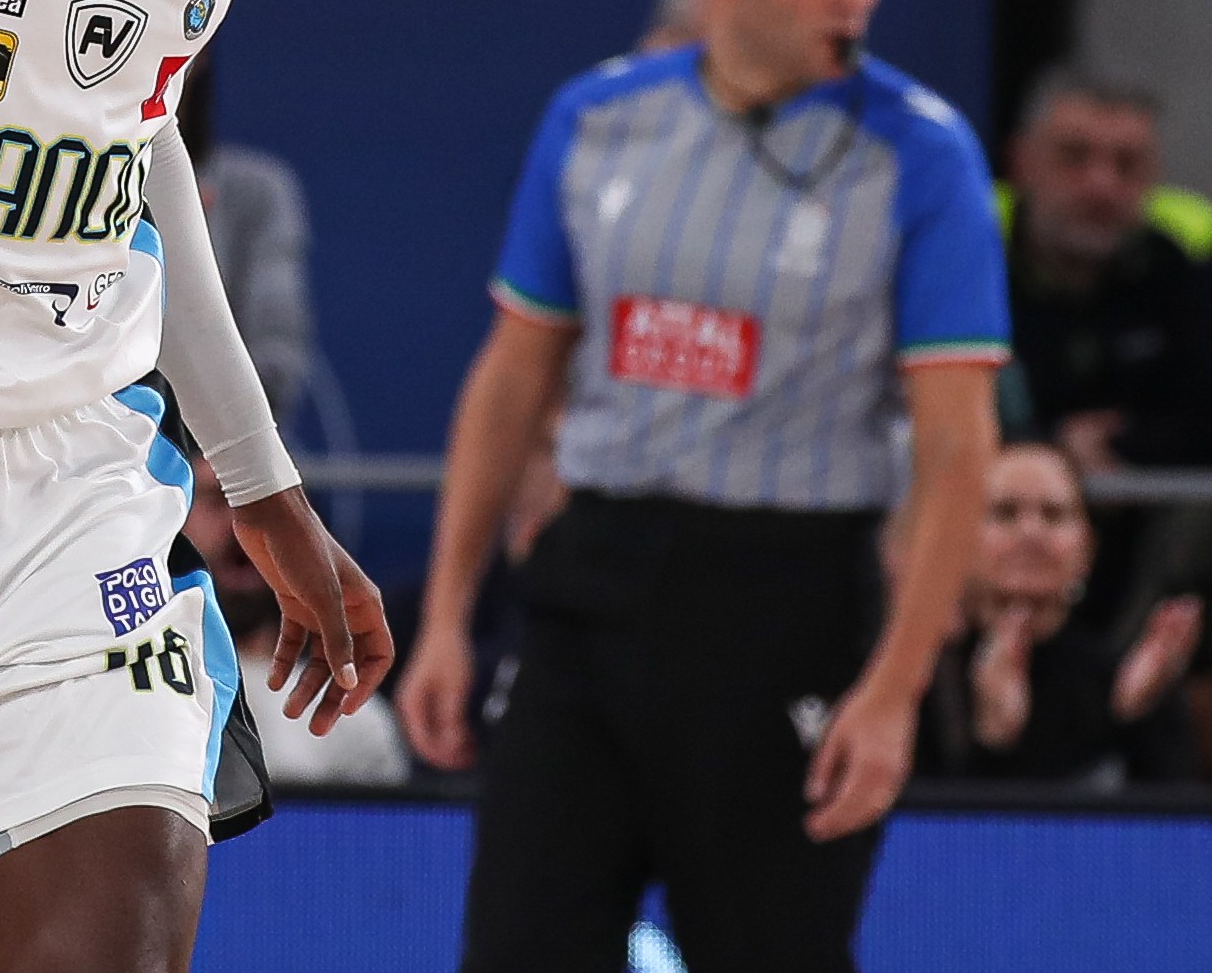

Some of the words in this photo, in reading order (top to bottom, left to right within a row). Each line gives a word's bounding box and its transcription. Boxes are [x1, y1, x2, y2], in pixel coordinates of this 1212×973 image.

[106, 564, 158, 592] POLO
[108, 586, 163, 614] DIGI
[113, 609, 153, 631] TA
